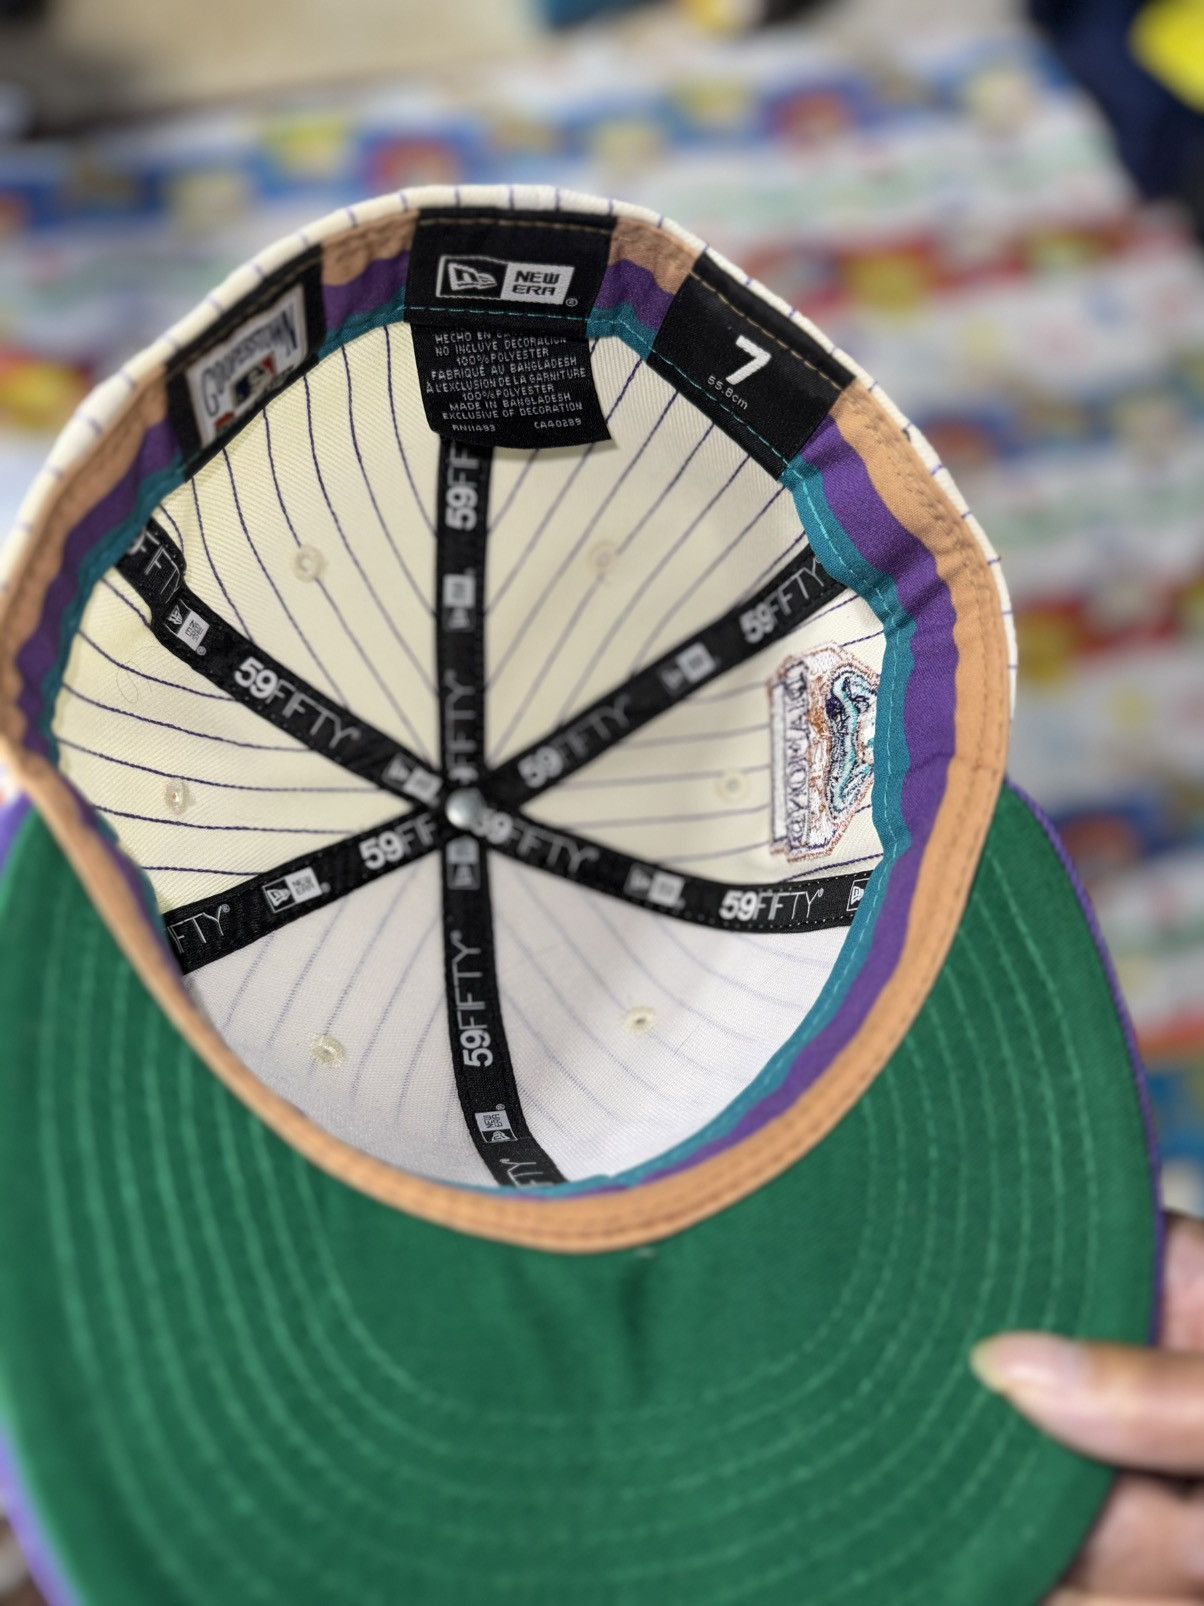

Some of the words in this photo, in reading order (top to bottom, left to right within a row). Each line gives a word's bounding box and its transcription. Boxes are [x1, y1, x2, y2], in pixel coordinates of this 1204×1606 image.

[514, 270, 560, 284] NEW
[512, 284, 556, 296] ERA
[435, 332, 472, 344] HECHO
[477, 331, 491, 341] EN
[435, 346, 450, 357] NO
[455, 341, 498, 354] INCLUYE
[491, 365, 505, 375] AU
[510, 356, 577, 374] BANGLADESH
[726, 335, 771, 385] 7
[499, 377, 511, 387] DE
[514, 375, 527, 385] LA
[529, 367, 586, 384] GARNITURE
[707, 375, 748, 410] 55.8cm
[442, 410, 499, 420] EXCLUSIVE
[503, 409, 514, 418] OF
[520, 402, 583, 417] DECORATION
[450, 402, 481, 412] MADE
[485, 399, 497, 409] IN
[503, 393, 571, 408] BANGLADESH
[534, 418, 582, 429] CA40289
[234, 656, 355, 749] 59FIFTY
[719, 889, 820, 921] 59FIFTY
[451, 932, 493, 1067] 59FIFTY
